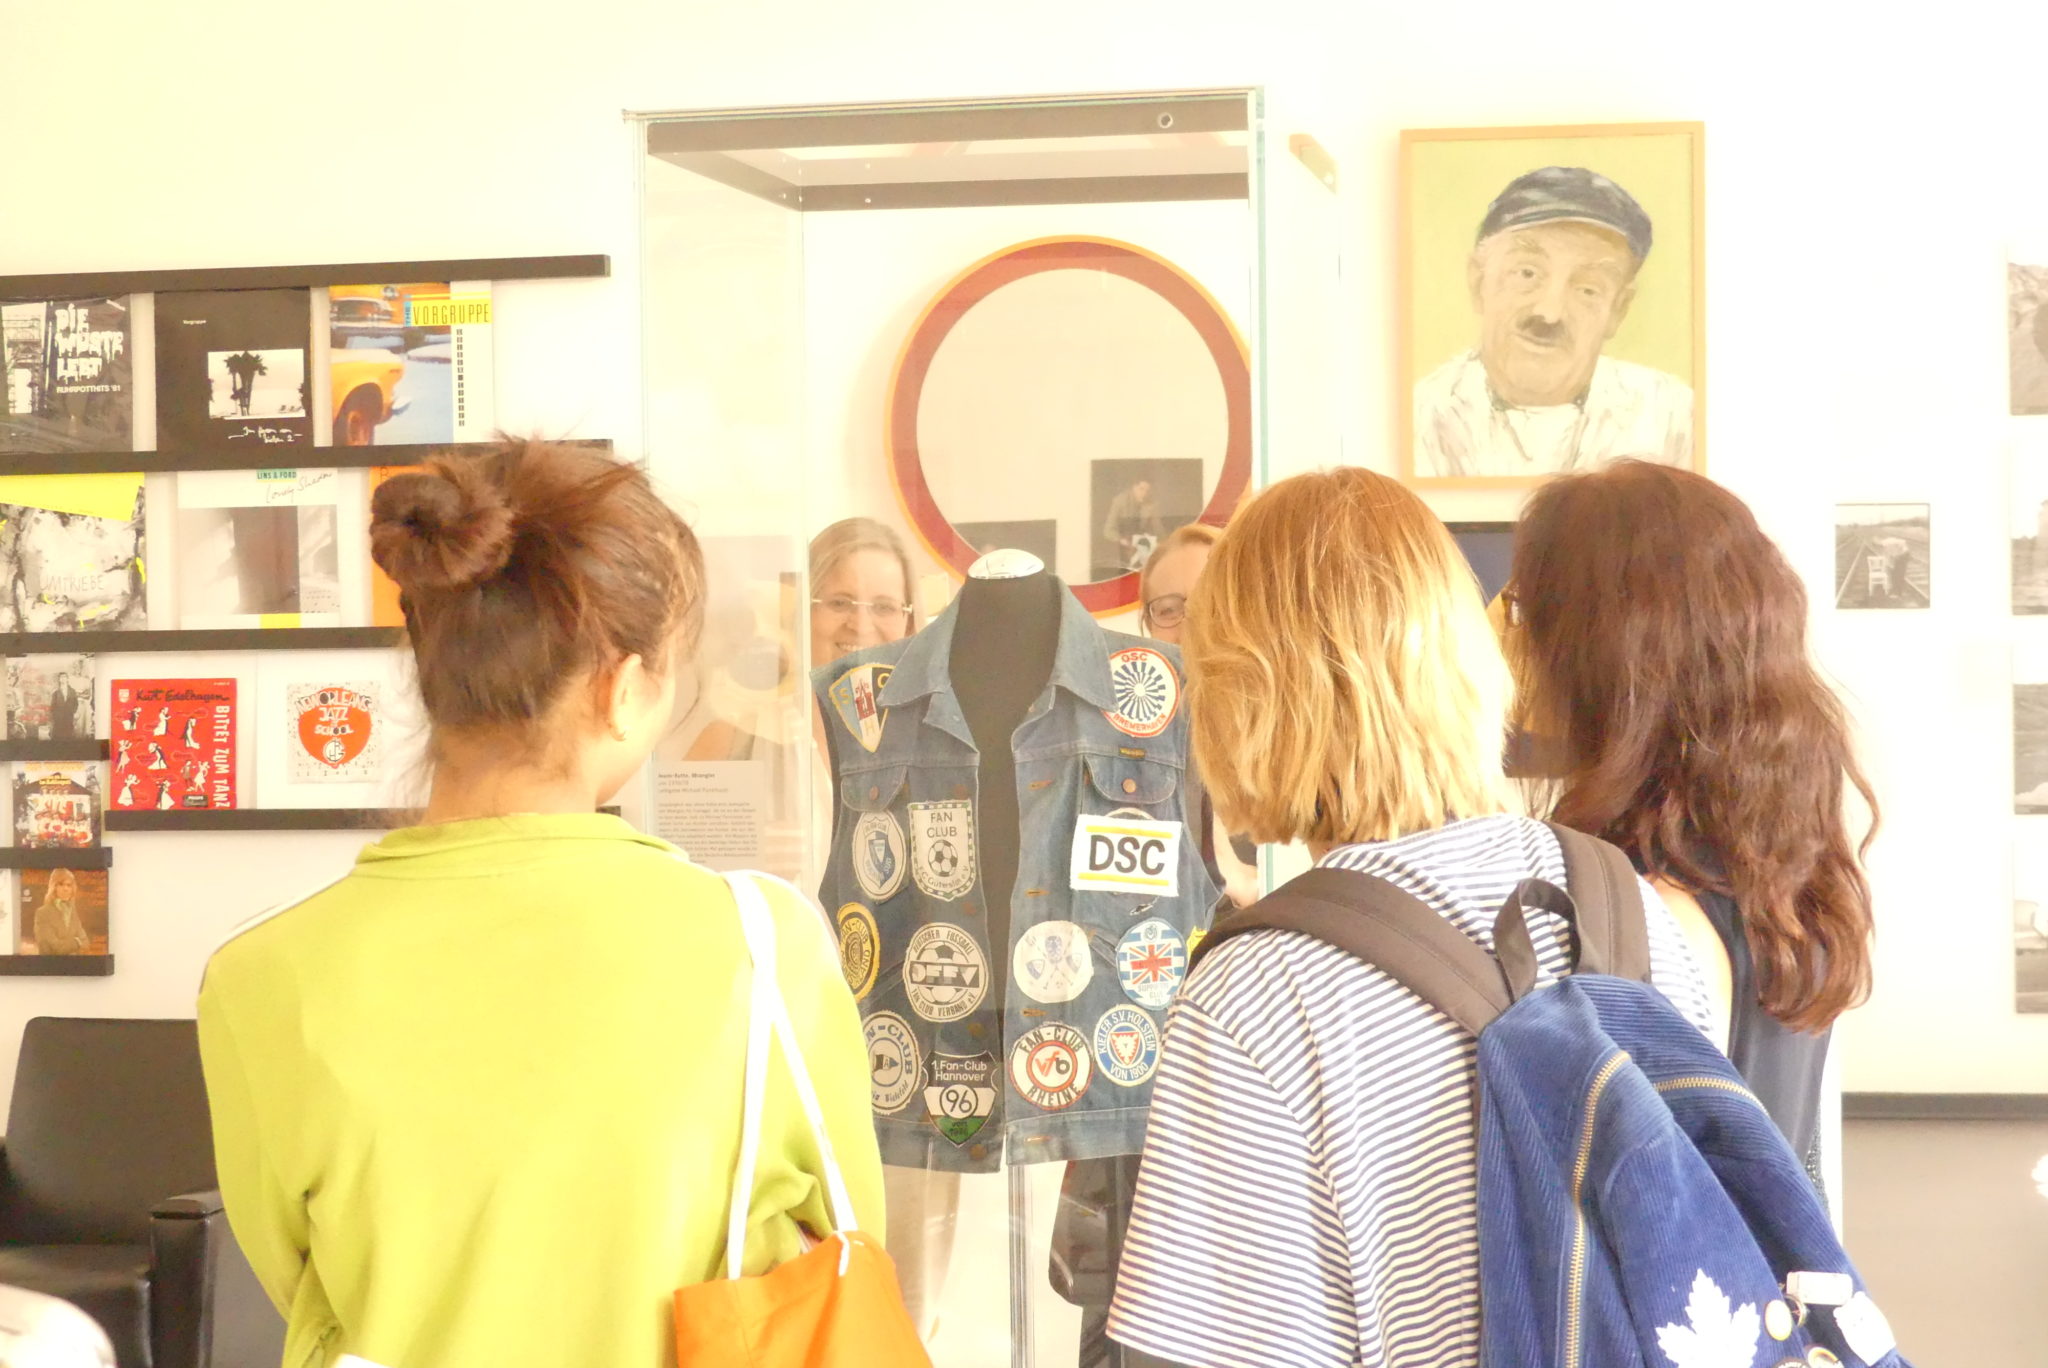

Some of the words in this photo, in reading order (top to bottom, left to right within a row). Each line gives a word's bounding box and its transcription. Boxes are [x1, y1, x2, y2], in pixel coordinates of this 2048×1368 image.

[413, 303, 489, 325] VORGRUPPE
[257, 471, 272, 480] LINS
[280, 471, 297, 480] FORD
[1121, 652, 1148, 663] OSC
[319, 707, 349, 722] JAZZ
[1113, 713, 1167, 731] BREMERHAVEN
[314, 724, 354, 736] SCHOOL
[212, 749, 231, 774] ZUM
[212, 779, 231, 808] TANZ
[930, 812, 953, 824] FAN
[926, 826, 958, 839] CLUB
[1088, 834, 1166, 876] DSC
[937, 1000, 968, 1017] VERBAND
[1098, 1019, 1112, 1054] KIELER
[1127, 1011, 1157, 1051] HOLSTEIN
[935, 1070, 985, 1081] Hannover
[1109, 1065, 1129, 1080] VON
[1129, 1061, 1150, 1080] 1900
[945, 1089, 973, 1113] 96
[1026, 1082, 1082, 1106] RHEINE
